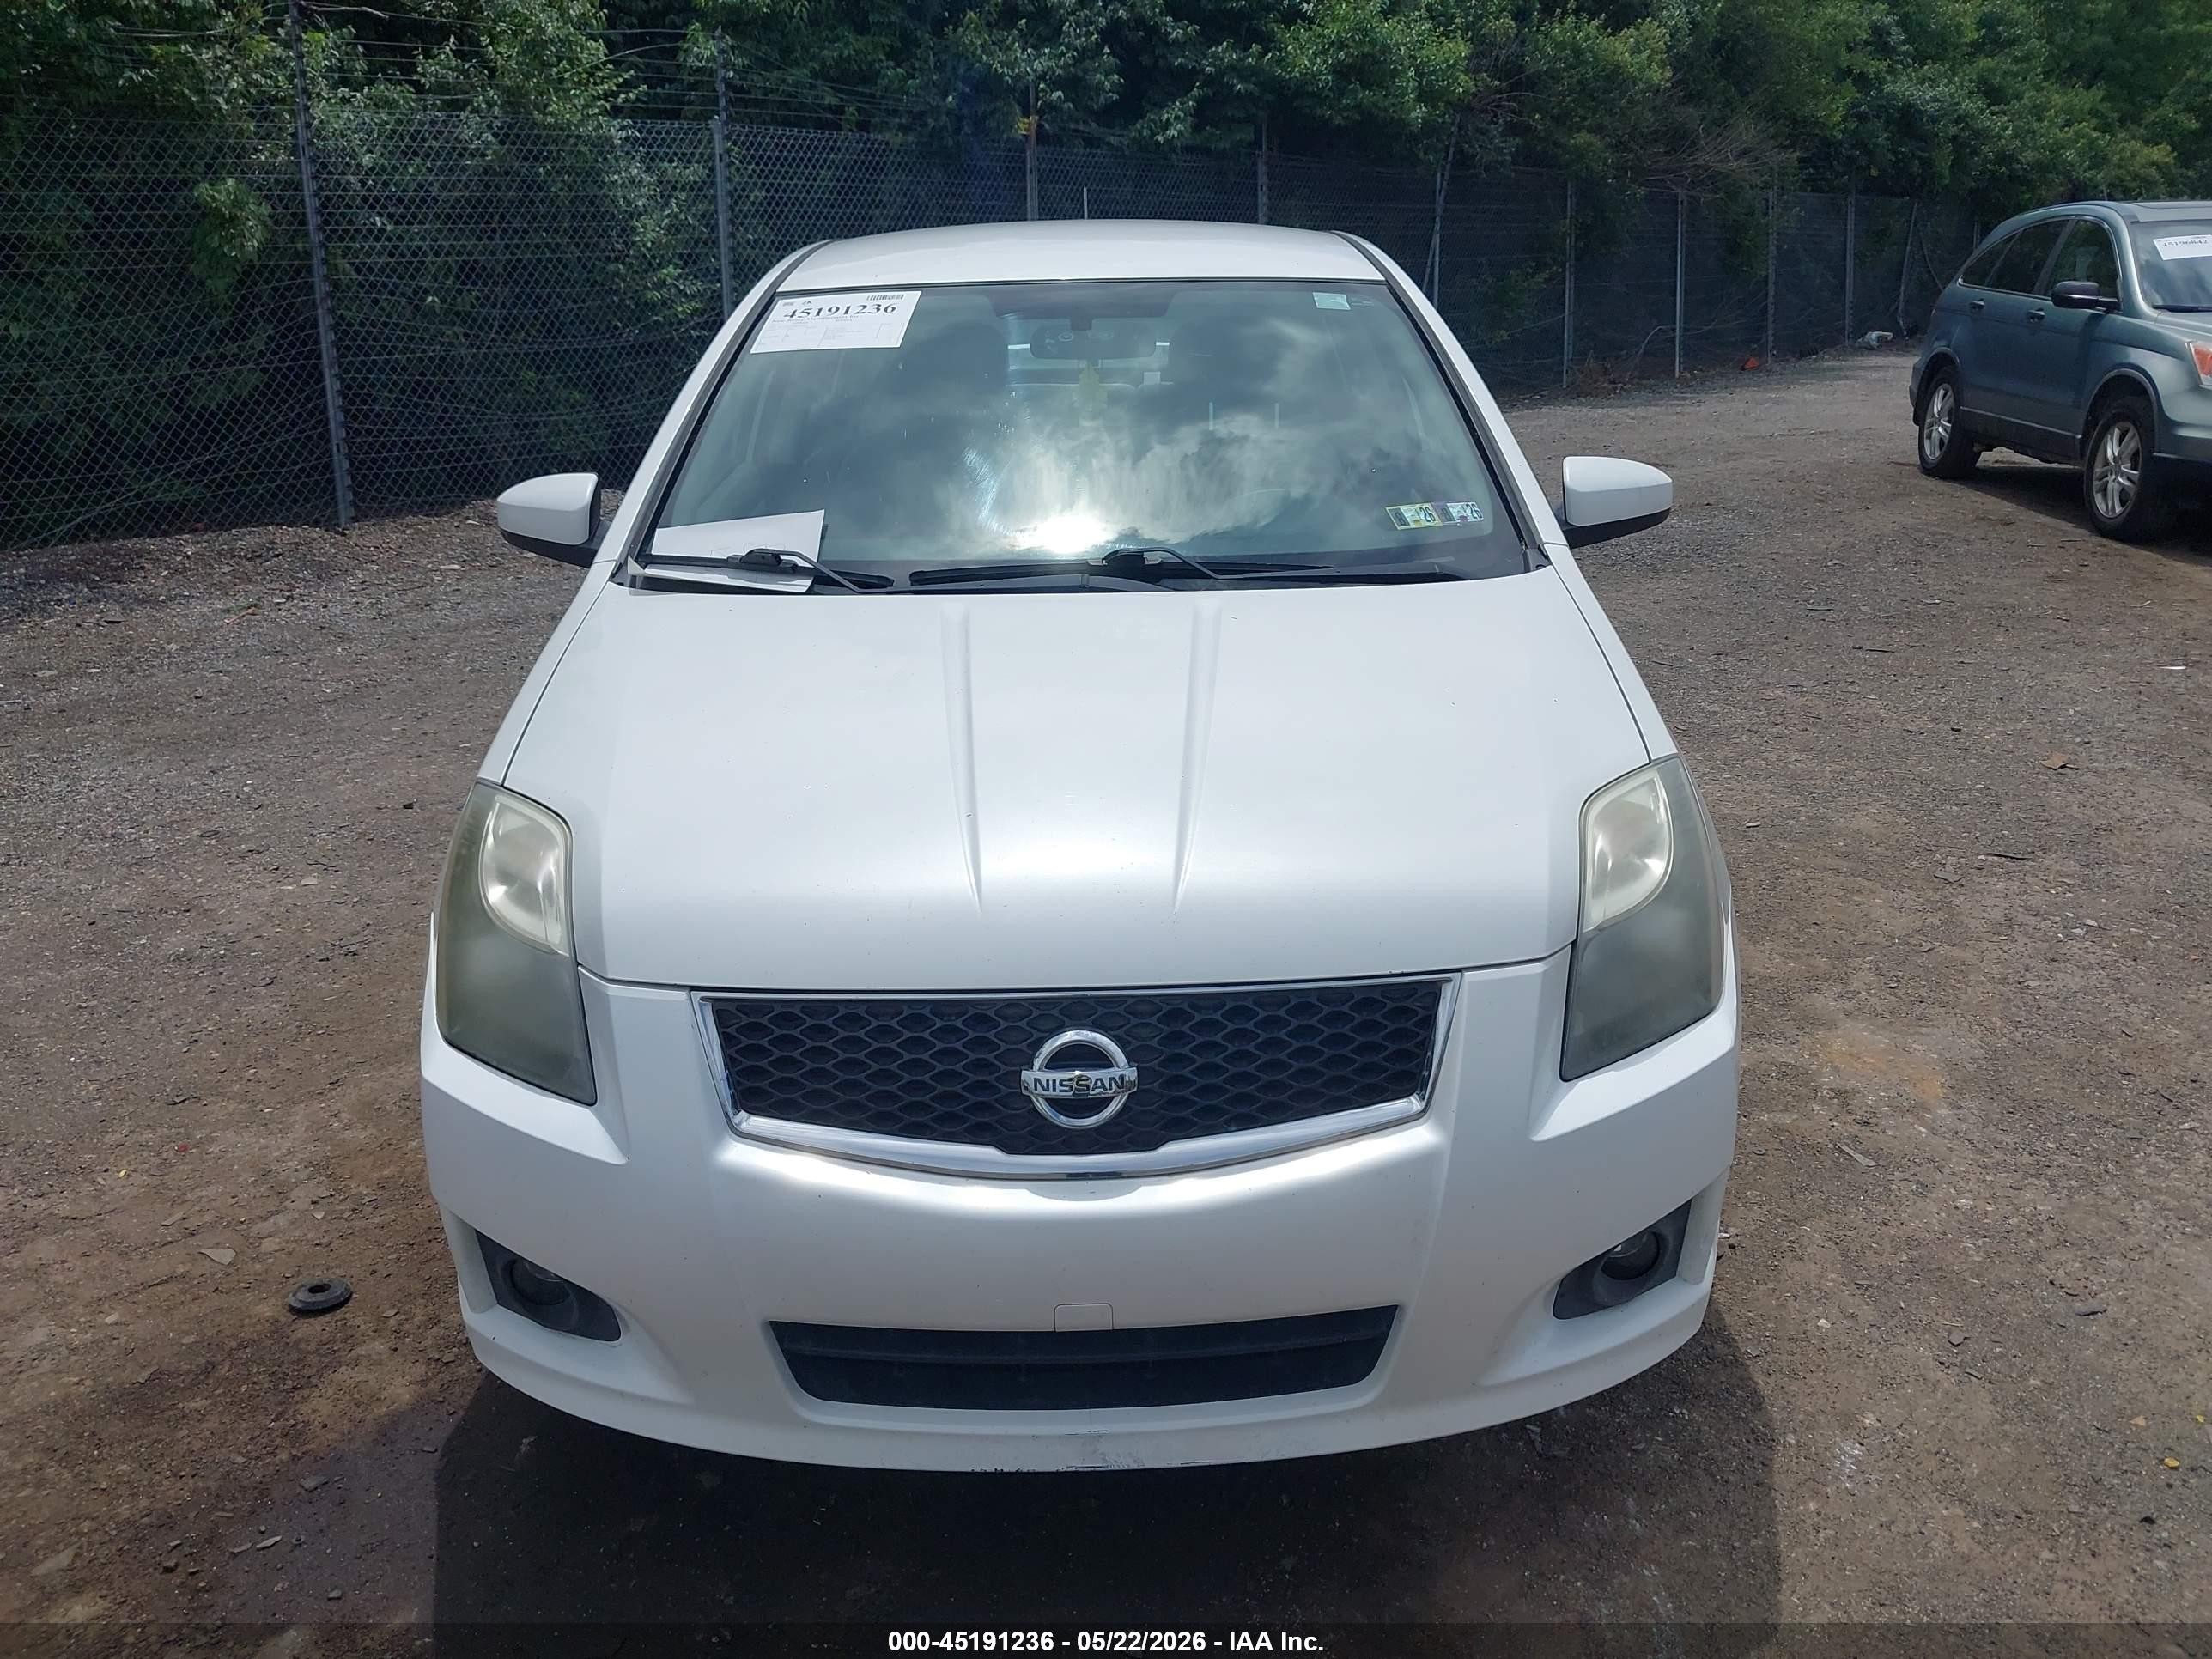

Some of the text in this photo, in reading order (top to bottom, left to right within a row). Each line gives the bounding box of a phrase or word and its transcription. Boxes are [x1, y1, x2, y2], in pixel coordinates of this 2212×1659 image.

[783, 303, 898, 319] 45191236
[1419, 506, 1436, 523] 26
[1466, 503, 1483, 520] 26
[1033, 1074, 1126, 1093] NISSAN
